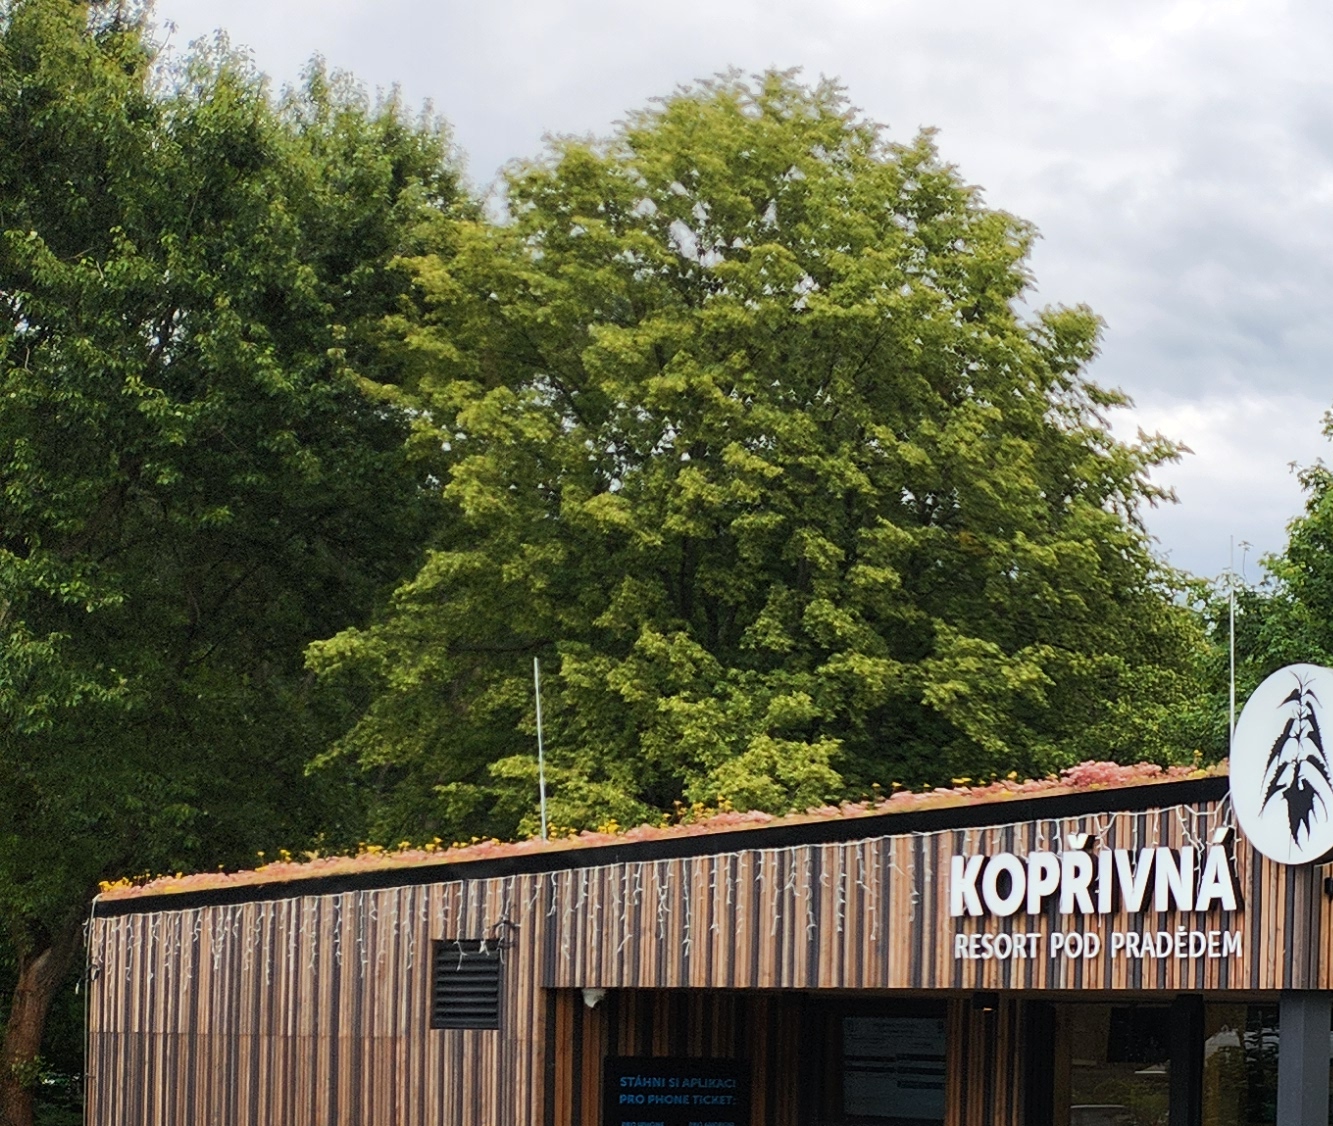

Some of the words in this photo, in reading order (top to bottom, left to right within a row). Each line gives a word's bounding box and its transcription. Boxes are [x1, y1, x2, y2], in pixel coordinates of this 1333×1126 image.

[950, 827, 1238, 917] KOPŘIVNÁ
[954, 932, 1042, 960] RESORT
[1050, 931, 1100, 959] POD
[1111, 926, 1243, 959] PRADĚDEM
[619, 1074, 666, 1088] STÁHNI
[619, 1093, 645, 1105] PRO
[647, 1094, 691, 1105] PHONE
